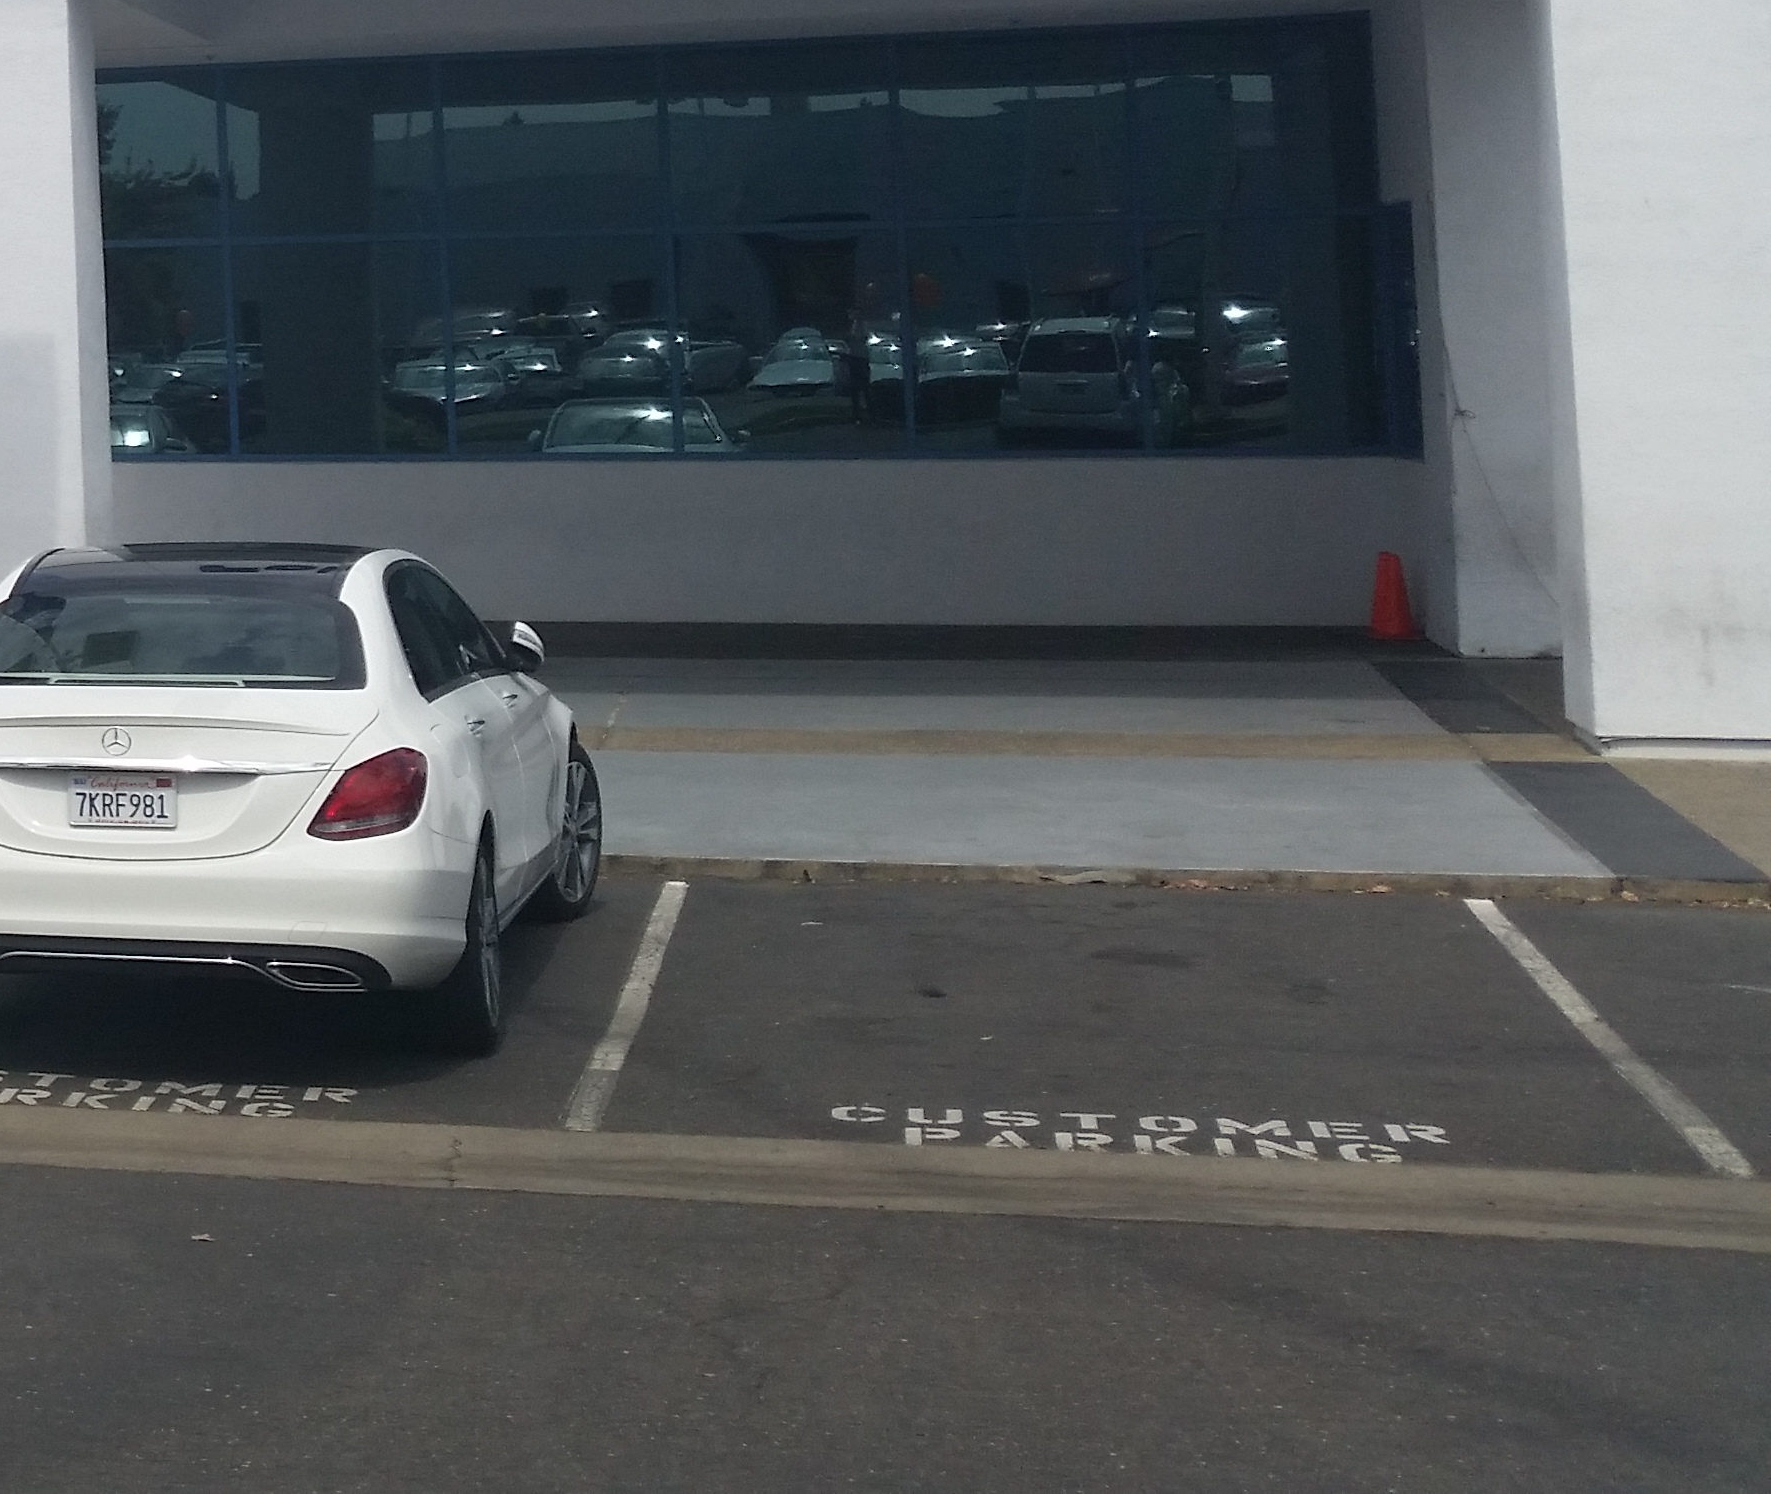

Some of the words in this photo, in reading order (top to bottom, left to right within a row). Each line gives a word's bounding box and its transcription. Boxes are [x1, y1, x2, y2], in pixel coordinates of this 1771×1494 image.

[75, 792, 170, 819] 7KRF981
[830, 1105, 1452, 1146] CUSTOMER
[904, 1126, 1403, 1164] PARKING
